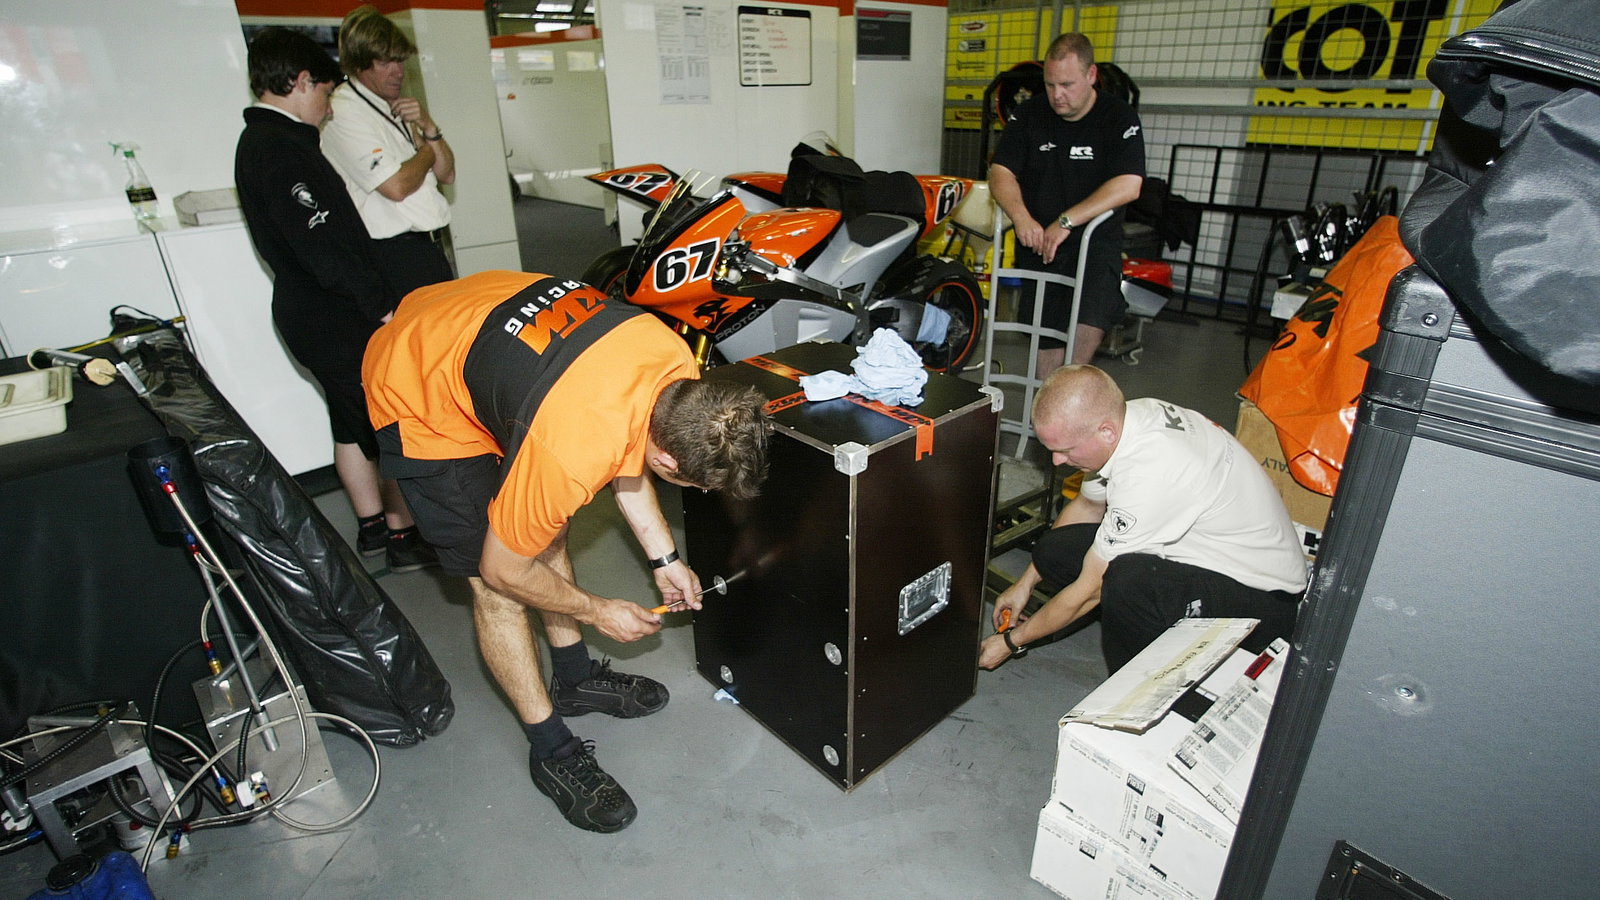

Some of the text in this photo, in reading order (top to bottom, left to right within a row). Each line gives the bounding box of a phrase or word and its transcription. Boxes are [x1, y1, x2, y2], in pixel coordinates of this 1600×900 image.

[1070, 146, 1094, 156] KR
[653, 237, 721, 293] 67
[517, 286, 610, 356] KTM
[715, 304, 766, 342] PROTON
